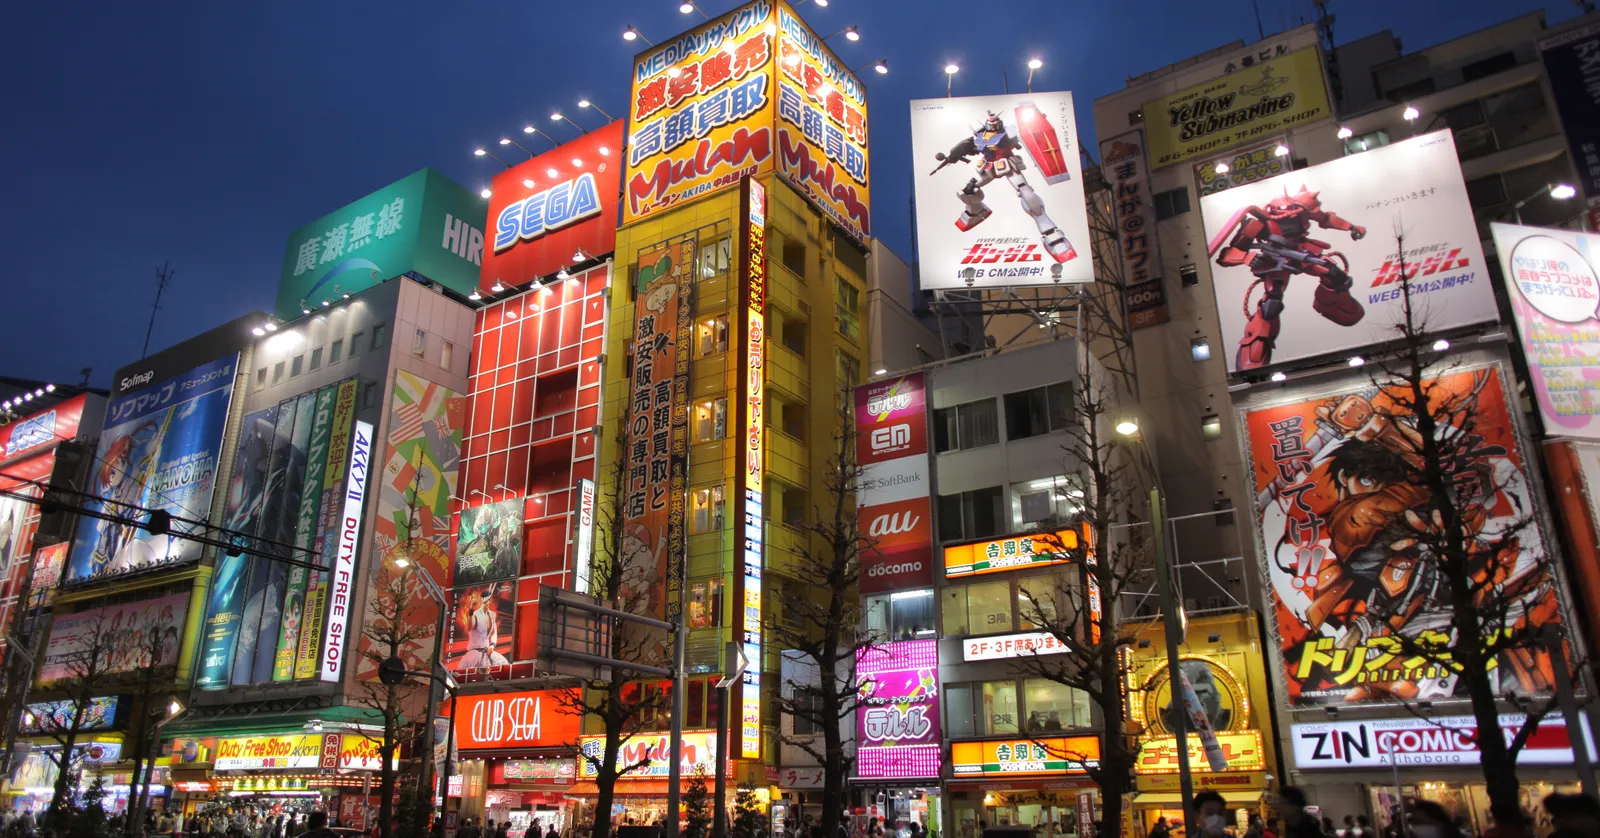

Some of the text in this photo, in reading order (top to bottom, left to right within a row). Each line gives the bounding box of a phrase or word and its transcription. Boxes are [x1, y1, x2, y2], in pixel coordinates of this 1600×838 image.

[635, 32, 769, 121] 激安販売
[1169, 82, 1228, 105] HOBBY BASE
[630, 73, 768, 167] 高額買取
[1168, 92, 1236, 127] Yellow
[1179, 93, 1295, 142] Submarine
[1250, 108, 1320, 135] RPG-SHOP
[779, 81, 866, 187] 高額買取
[628, 127, 772, 215] Mulan
[778, 129, 870, 236] Mulan
[494, 172, 602, 252] SEGA
[961, 243, 1042, 264] ガンダム
[1514, 257, 1569, 272] やはり俺の
[1368, 289, 1400, 304] WEB
[1136, 311, 1155, 325] 3F
[120, 370, 154, 391] Sofmap
[112, 381, 176, 421] ソフマップ
[867, 390, 912, 416] テルル
[351, 430, 369, 489] AKKY
[877, 472, 920, 488] SoftBank
[582, 485, 593, 527] GAME
[869, 510, 920, 537] au
[341, 517, 357, 565] DUTY
[986, 539, 1034, 558] 吉野家
[868, 561, 923, 577] docomo
[334, 570, 349, 617] FREE
[327, 623, 342, 673] SHOP
[1357, 667, 1450, 684] DRIFTERS
[472, 696, 541, 743] CLUB SEGA
[864, 705, 931, 741] テルル
[1372, 720, 1415, 728] Professional
[220, 741, 242, 758] Duty
[243, 739, 265, 756] Free
[266, 738, 292, 757] Shop
[323, 734, 339, 768] 免税店
[996, 742, 1047, 762] 吉野家
[1301, 723, 1370, 764] ZIN
[1378, 729, 1476, 752] COMIC
[1000, 762, 1045, 771] YOSHINOYA
